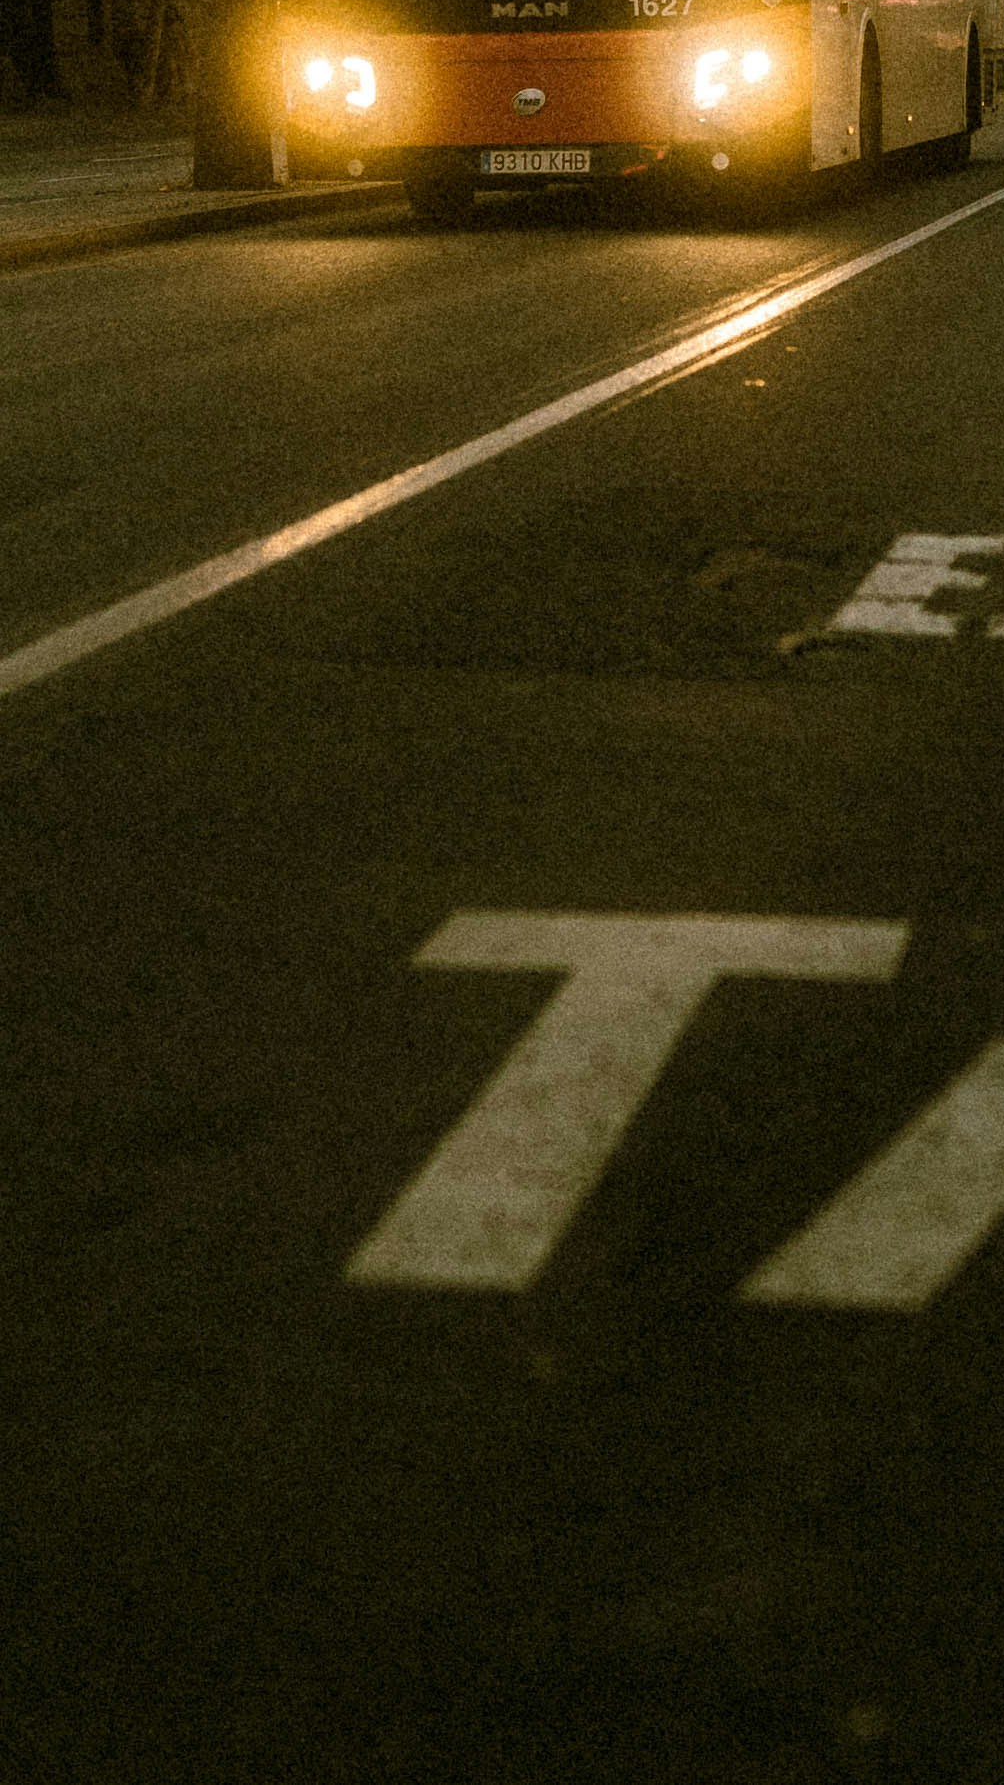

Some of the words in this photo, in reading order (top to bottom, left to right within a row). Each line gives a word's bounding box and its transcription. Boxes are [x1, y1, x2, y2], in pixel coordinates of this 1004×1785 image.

[491, 1, 568, 17] MAN
[518, 98, 541, 107] TMB
[494, 153, 542, 171] 9310
[549, 153, 586, 171] KHB
